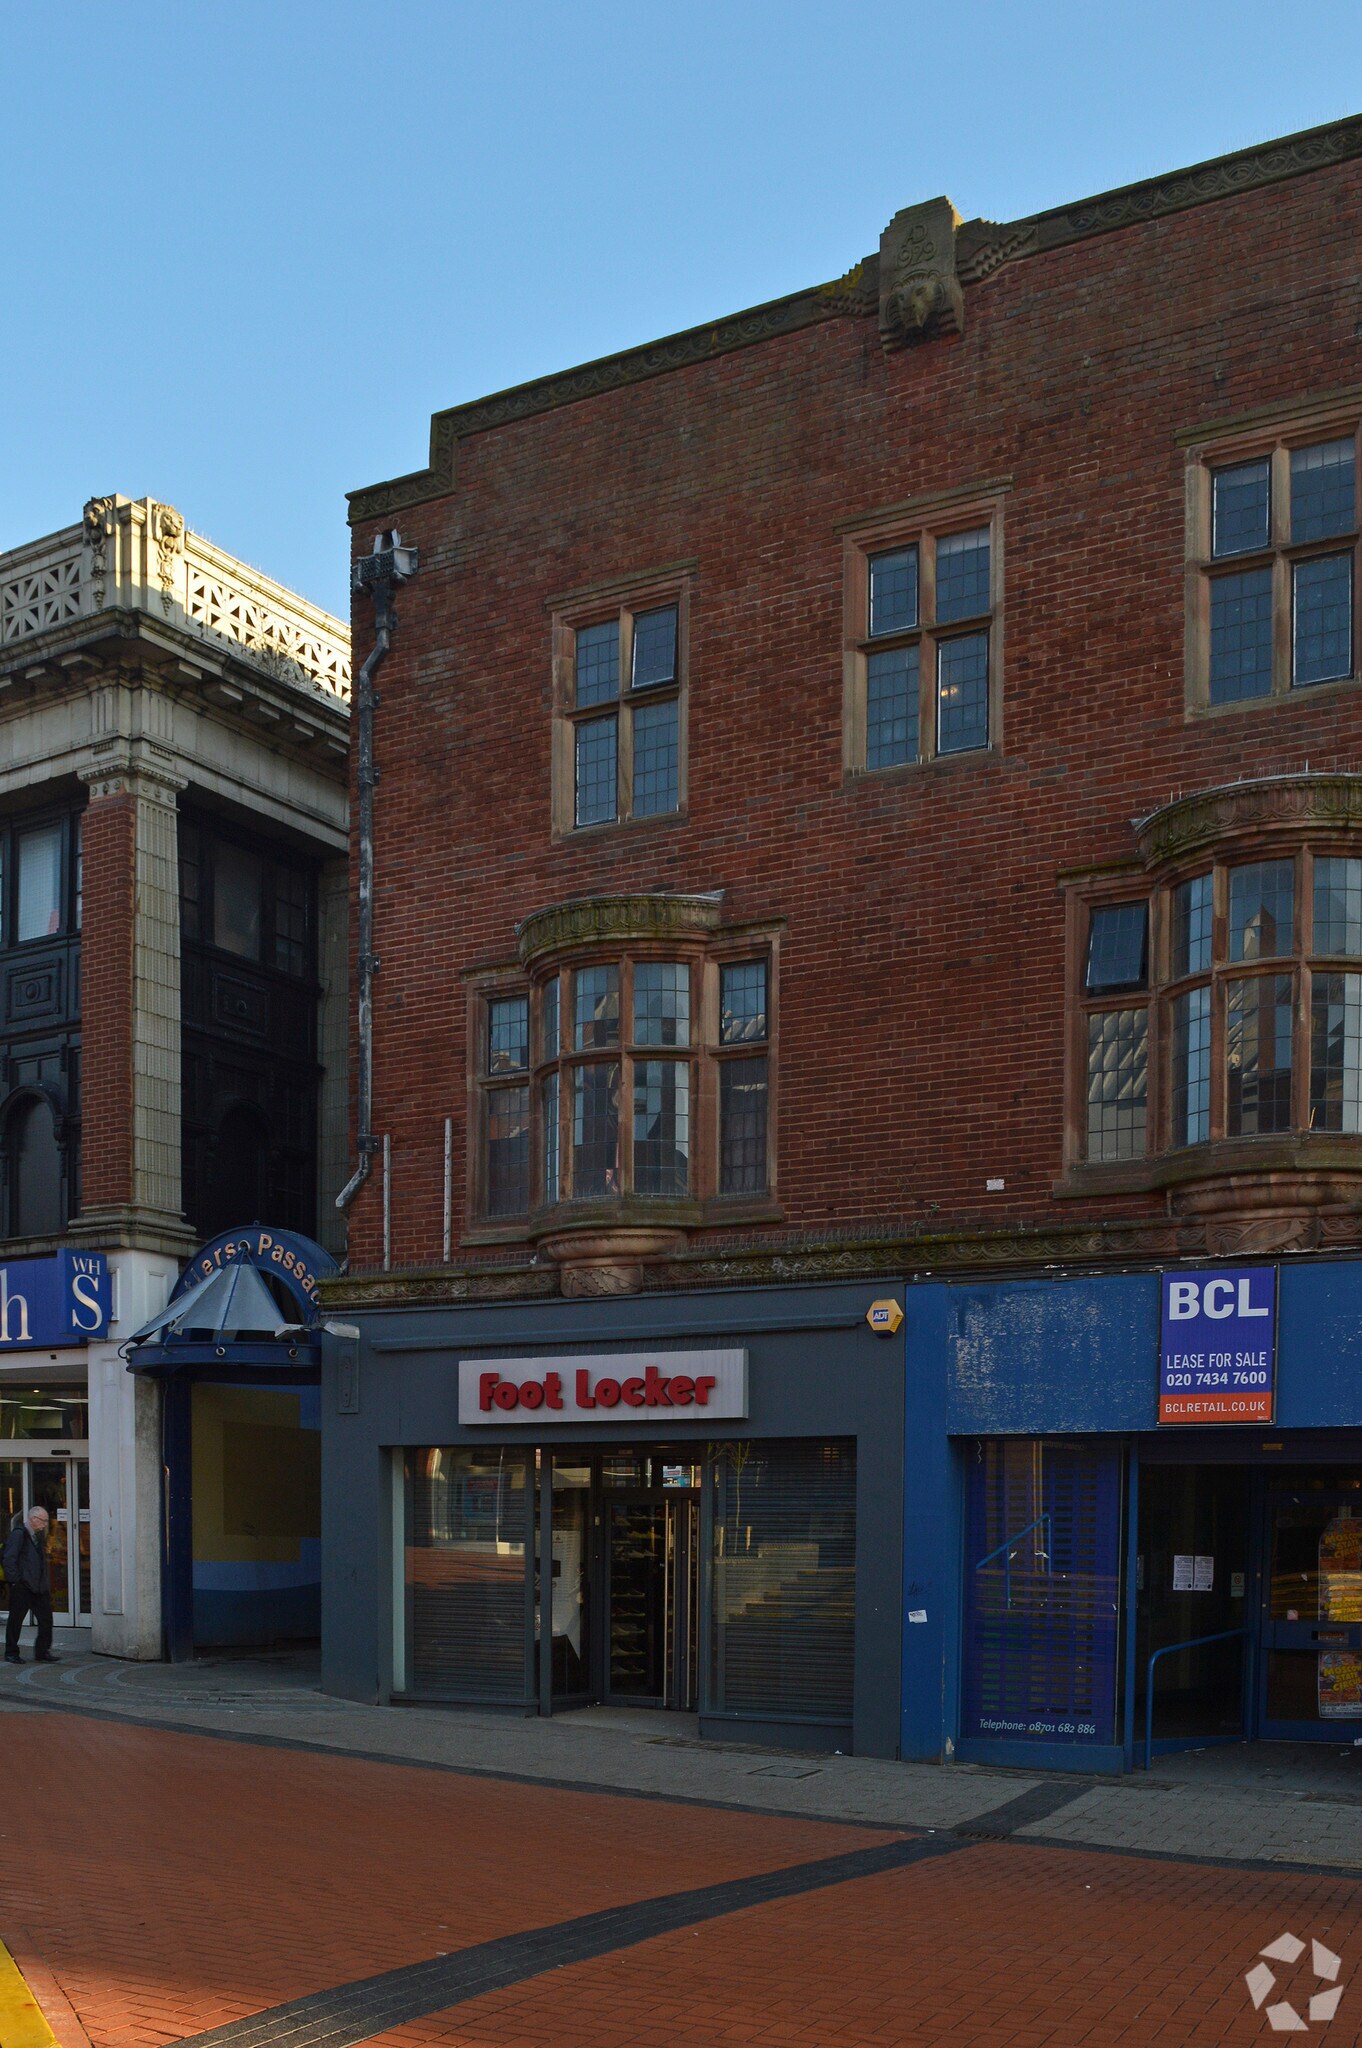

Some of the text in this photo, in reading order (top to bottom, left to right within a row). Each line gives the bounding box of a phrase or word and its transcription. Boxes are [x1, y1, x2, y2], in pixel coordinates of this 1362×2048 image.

[72, 1256, 101, 1276] WH
[71, 1274, 103, 1331] S
[1169, 1279, 1269, 1320] BCL
[873, 1311, 889, 1320] ADT
[1166, 1351, 1267, 1369] LEASE FOR SALE
[1166, 1371, 1267, 1387] 020 7434 7600
[479, 1366, 716, 1411] Foot Locker
[1165, 1401, 1265, 1413] BCLRETAIL.CO.UK
[979, 1719, 1096, 1734] Telephone: 08701 682 886
